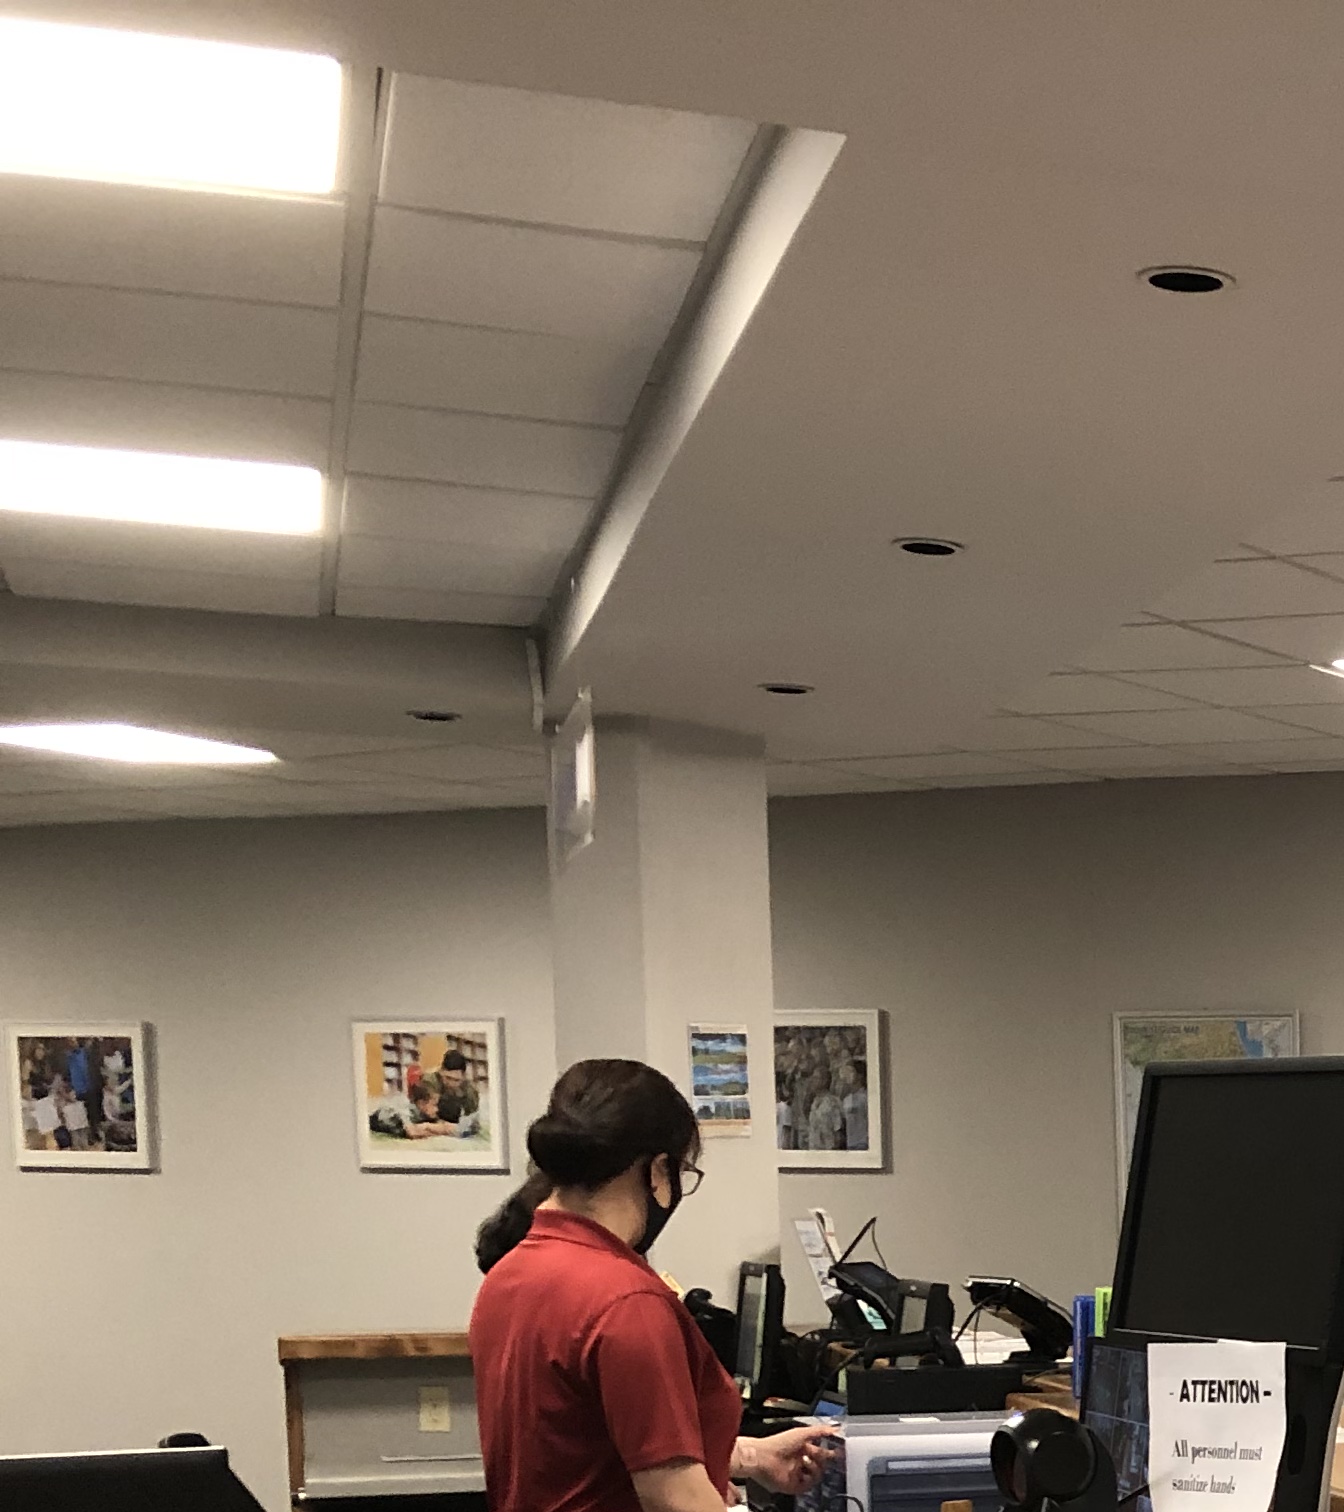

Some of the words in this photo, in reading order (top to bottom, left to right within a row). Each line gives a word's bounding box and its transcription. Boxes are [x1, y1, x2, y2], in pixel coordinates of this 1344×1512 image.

[1179, 1379, 1260, 1404] ATTENTION
[1172, 1439, 1188, 1458] All
[1191, 1441, 1237, 1464] personnel
[1239, 1446, 1263, 1461] must
[1172, 1473, 1208, 1493] sanitize
[1210, 1475, 1236, 1494] hands
